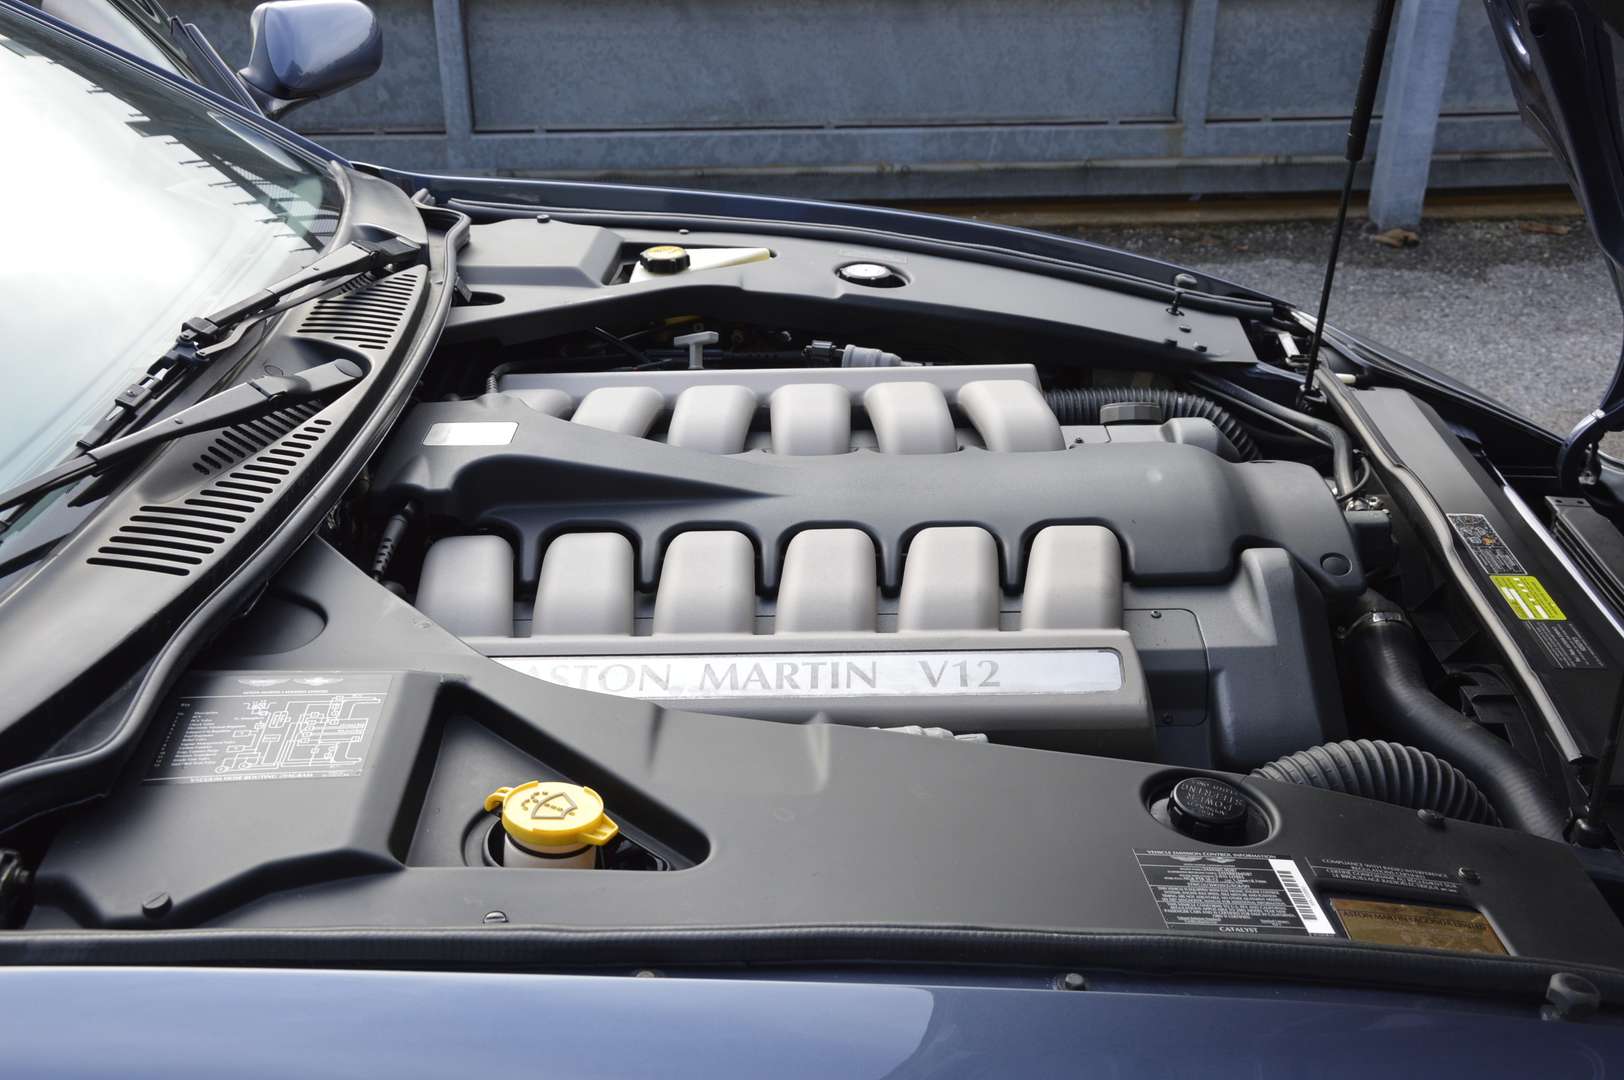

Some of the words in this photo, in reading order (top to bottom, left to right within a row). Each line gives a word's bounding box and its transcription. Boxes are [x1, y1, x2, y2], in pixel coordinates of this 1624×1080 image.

[699, 661, 877, 690] MARTIN
[918, 659, 1001, 688] V12
[1218, 926, 1259, 935] CATALYST
